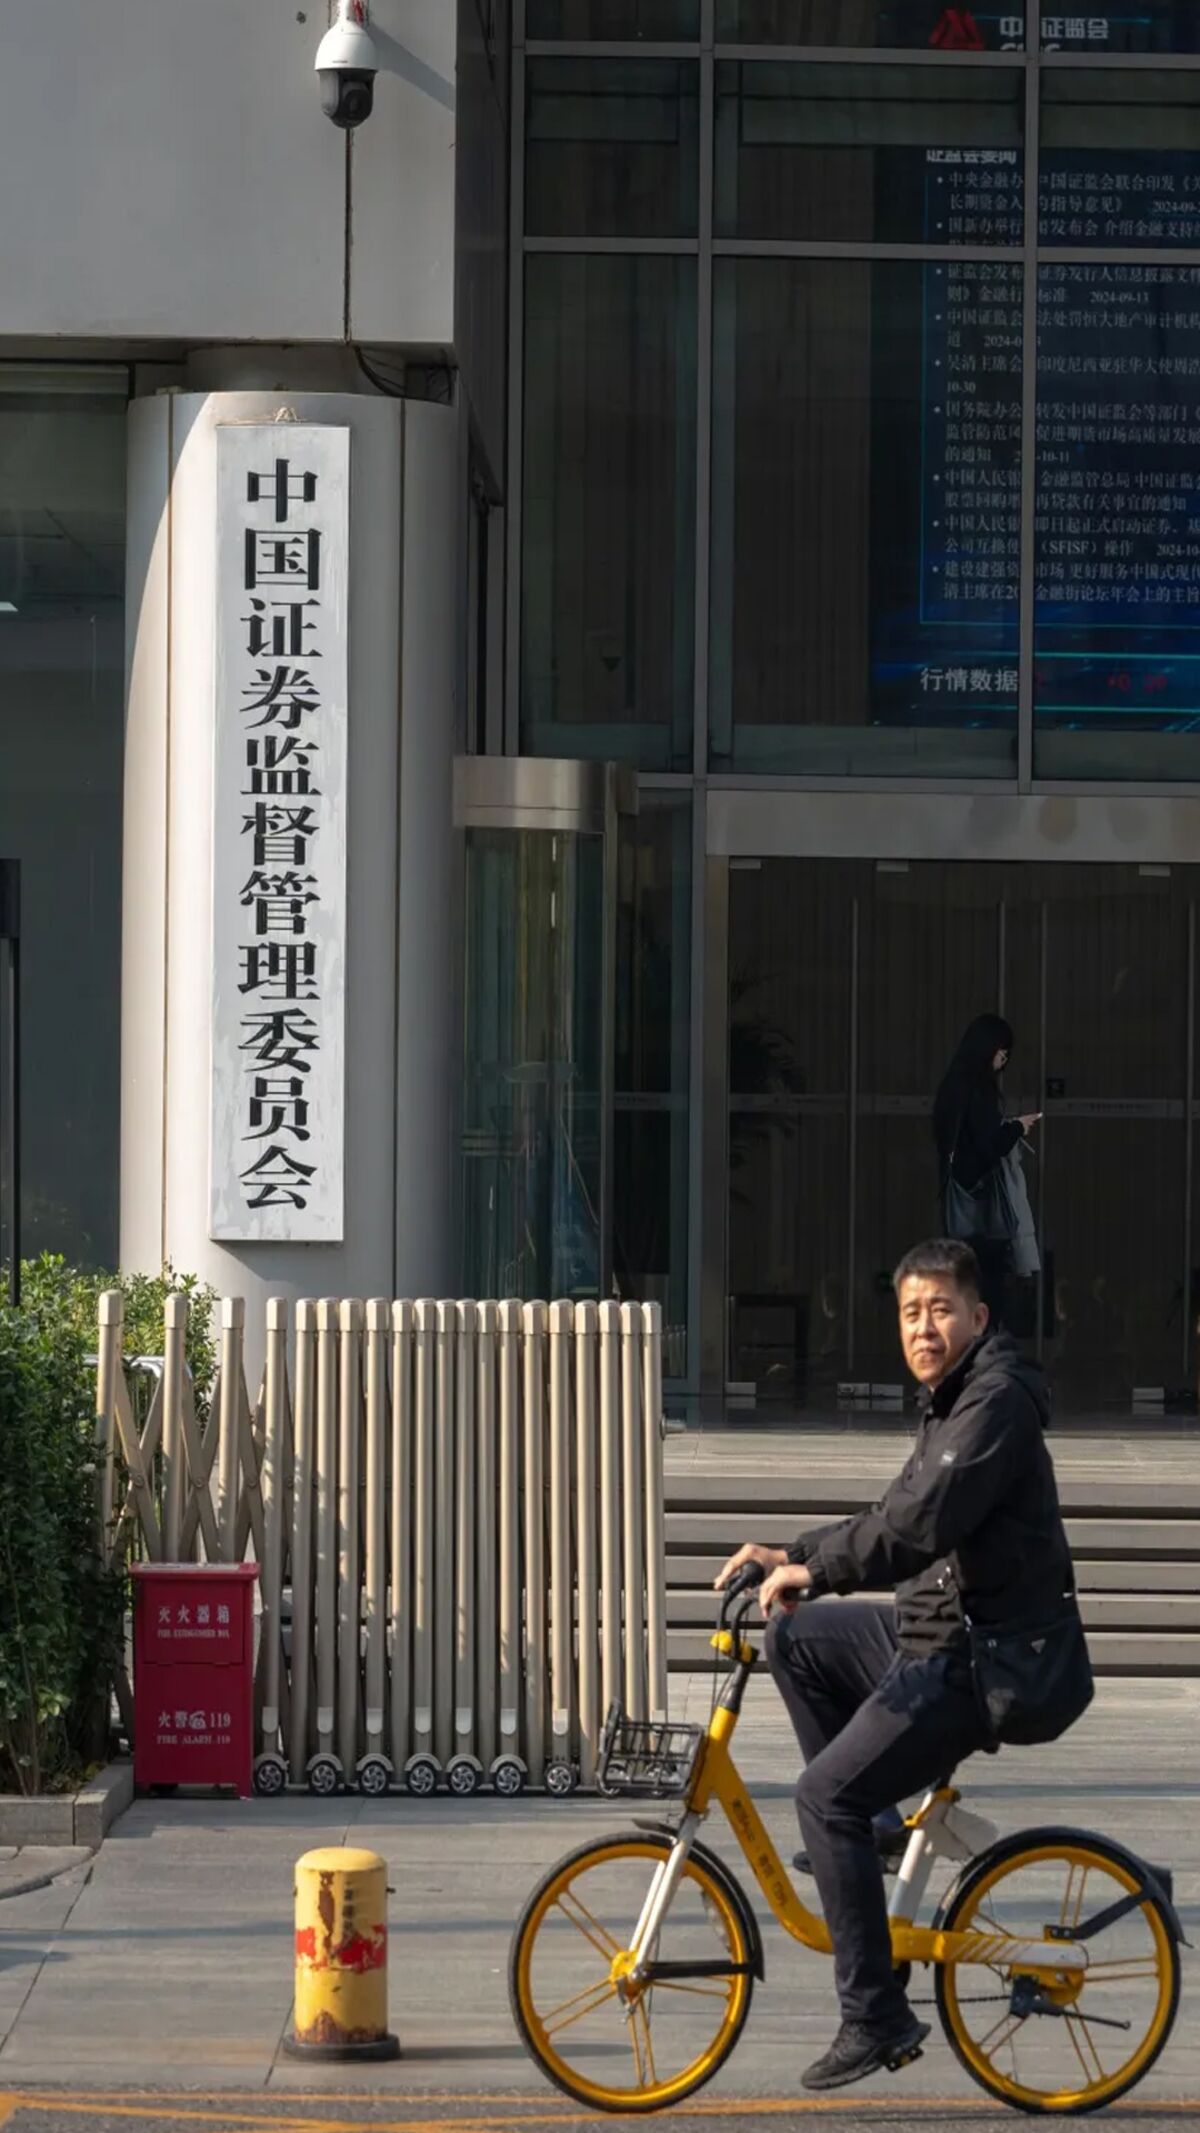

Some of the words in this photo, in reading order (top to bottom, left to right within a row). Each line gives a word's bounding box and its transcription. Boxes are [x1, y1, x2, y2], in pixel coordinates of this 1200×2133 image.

[999, 16, 1109, 39] 中证监会
[920, 668, 1018, 692] 行情数据
[236, 457, 323, 1210] 中国证券监督管理委员会
[158, 1604, 230, 1624] 灭火器箱
[158, 1711, 188, 1728] 火警
[210, 1712, 231, 1728] 119
